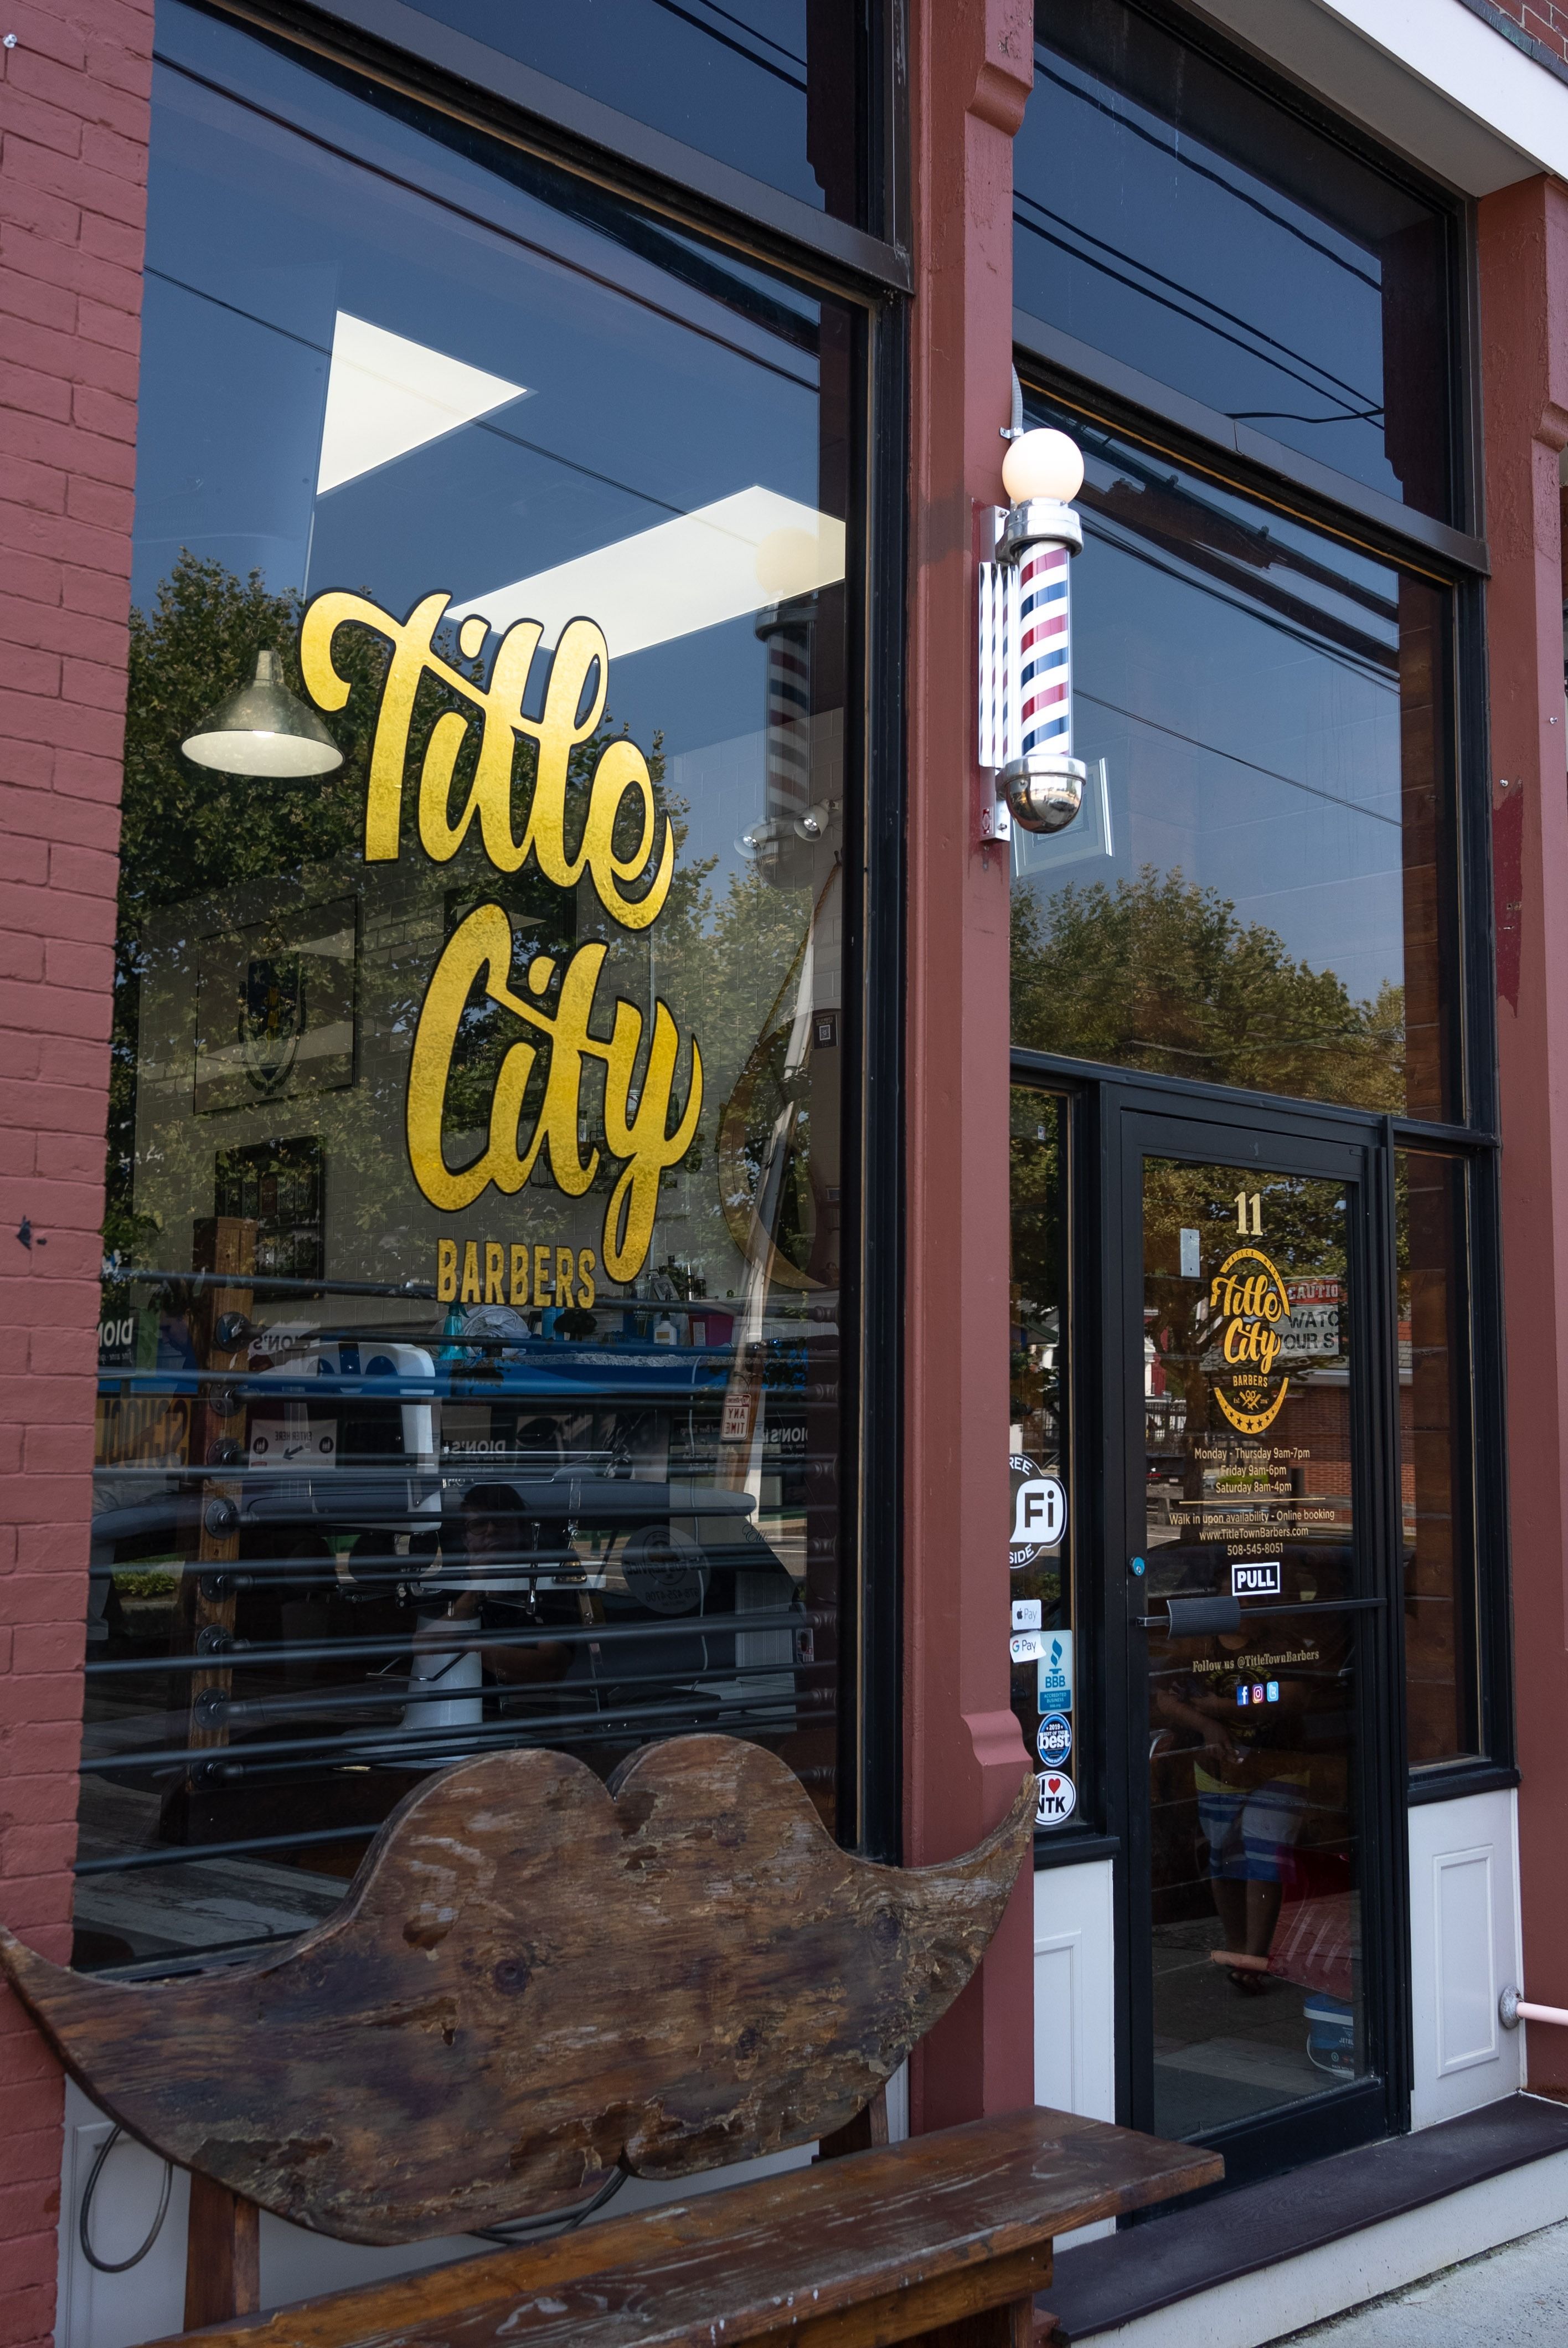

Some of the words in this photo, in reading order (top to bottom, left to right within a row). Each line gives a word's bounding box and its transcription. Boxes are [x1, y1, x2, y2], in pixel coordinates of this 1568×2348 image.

[301, 589, 675, 930] Title
[406, 902, 704, 1284] City
[1234, 1191, 1263, 1236] 11
[436, 1238, 596, 1309] BARBERS
[1225, 1249, 1254, 1267] NATICK
[1263, 1258, 1280, 1283] MASS
[1211, 1274, 1282, 1322] Title
[1288, 1284, 1338, 1300] CAUTIO
[1223, 1317, 1282, 1375] City
[1232, 1374, 1268, 1387] BARBERS
[1194, 1448, 1227, 1460] Monday
[1235, 1448, 1272, 1460] Thursday
[1273, 1447, 1311, 1460] 9am-7pm
[1220, 1465, 1246, 1477] Friday
[1249, 1464, 1287, 1477] 9am-6pm
[1215, 1482, 1252, 1495] Saturday
[1254, 1481, 1292, 1494] 8am-4pm
[1024, 1490, 1055, 1528] Fi
[1169, 1513, 1190, 1525] Walk
[1192, 1512, 1200, 1524] in
[1203, 1513, 1224, 1526] upon
[1226, 1511, 1269, 1524] availability
[1276, 1510, 1302, 1521] Online
[1304, 1508, 1335, 1521] booking
[1199, 1527, 1309, 1541] www.TitleTownBarbers.com
[1227, 1542, 1283, 1556] 508-545-8051
[1237, 1569, 1275, 1589] PULL
[1024, 1608, 1037, 1622] Pay
[1022, 1639, 1036, 1653] Pay
[1192, 1659, 1221, 1674] Follow
[1224, 1659, 1235, 1669] us
[1237, 1649, 1320, 1669] @TitleTownBarbers
[1045, 1675, 1066, 1689] BBB
[1039, 1729, 1071, 1750] best
[1041, 1779, 1045, 1795] I
